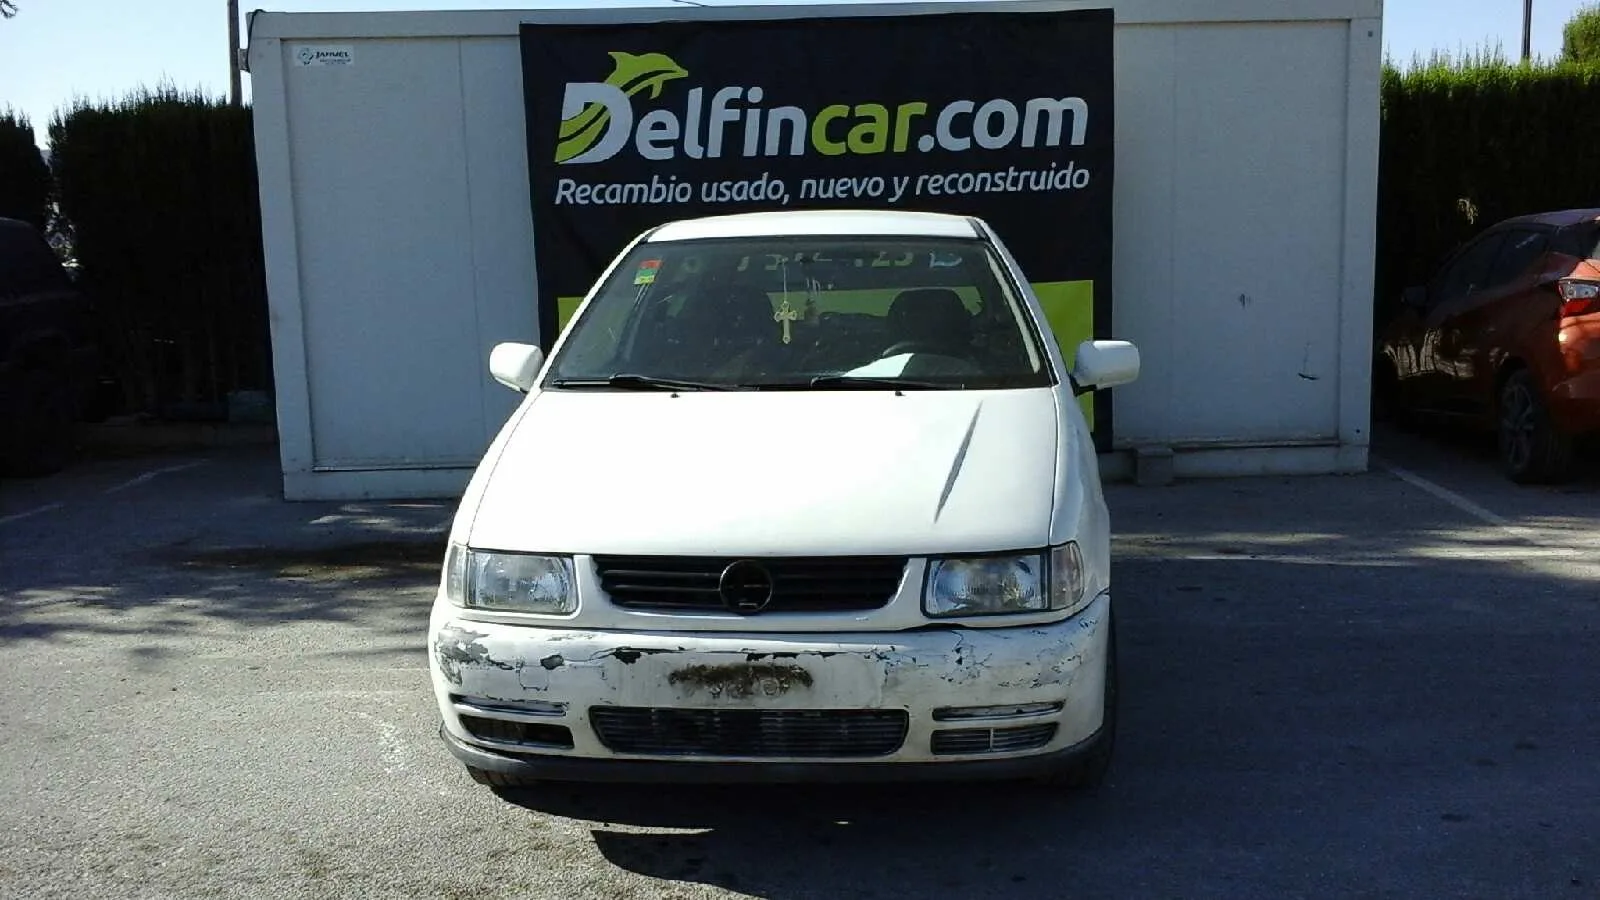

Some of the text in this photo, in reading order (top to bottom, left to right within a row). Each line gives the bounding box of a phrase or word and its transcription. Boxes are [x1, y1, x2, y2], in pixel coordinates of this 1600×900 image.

[555, 82, 1089, 163] Delfincar.com
[556, 161, 1090, 205] Recambio usado, nuevo y reconstruido
